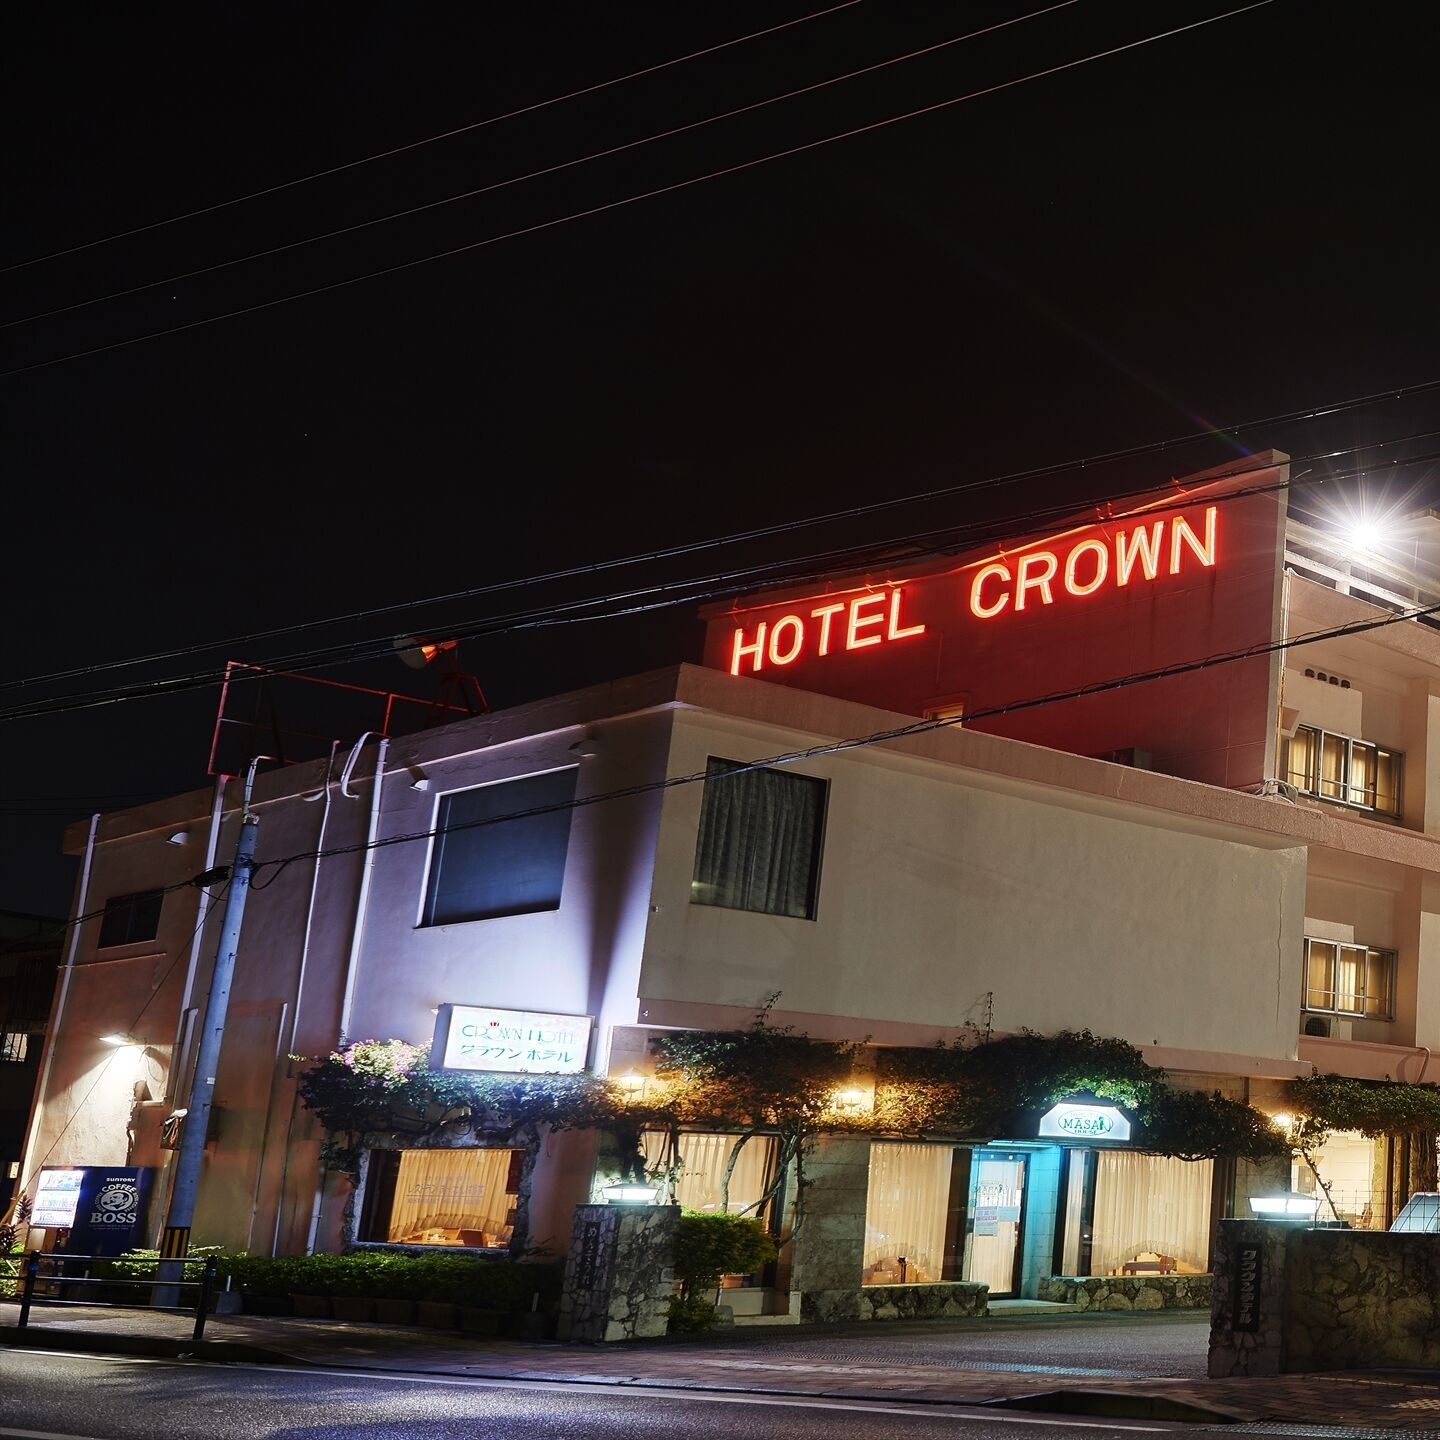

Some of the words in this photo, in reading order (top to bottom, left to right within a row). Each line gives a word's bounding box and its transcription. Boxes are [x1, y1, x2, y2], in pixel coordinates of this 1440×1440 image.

[730, 589, 926, 676] HOTEL
[969, 506, 1217, 619] CROWN
[462, 1025, 522, 1042] CROWN
[101, 1183, 137, 1194] COFFEE
[90, 1212, 137, 1224] BOSS
